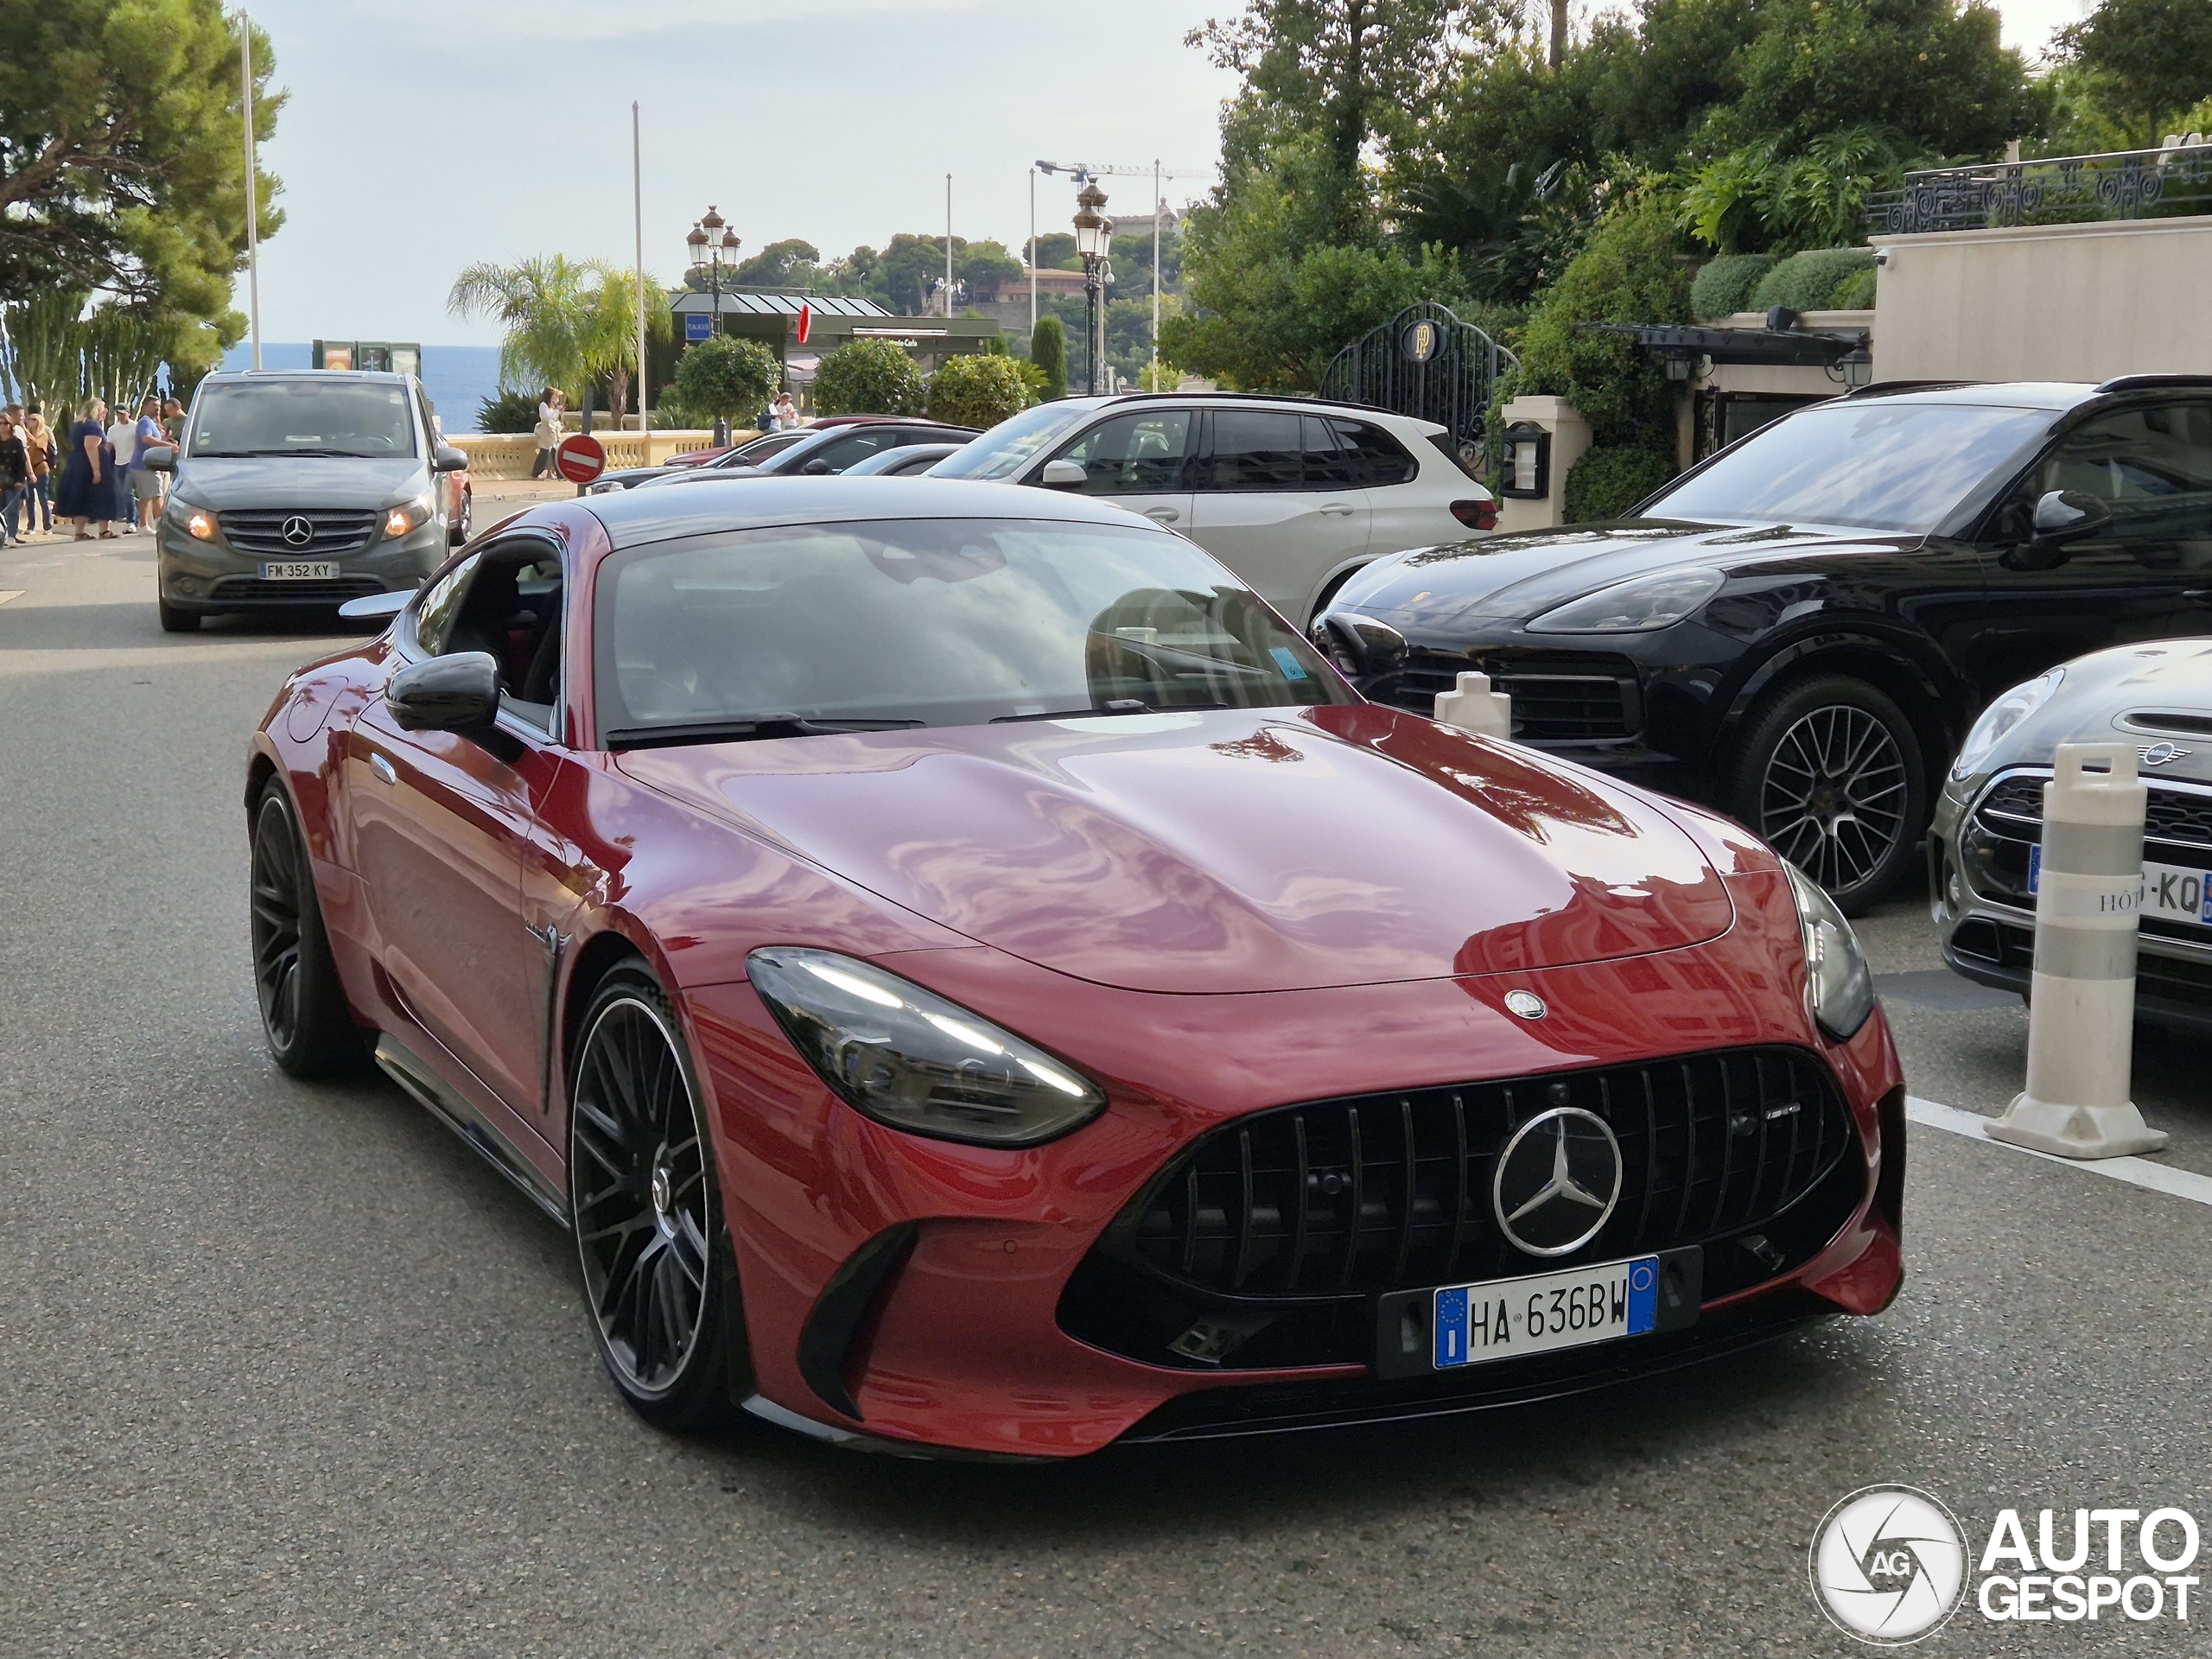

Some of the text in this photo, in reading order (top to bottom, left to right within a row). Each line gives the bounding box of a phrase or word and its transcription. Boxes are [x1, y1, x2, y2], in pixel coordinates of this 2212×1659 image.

[267, 564, 329, 577] FM-352-KY
[2139, 870, 2201, 915] -KQ
[1470, 1279, 1627, 1348] HA 636BW
